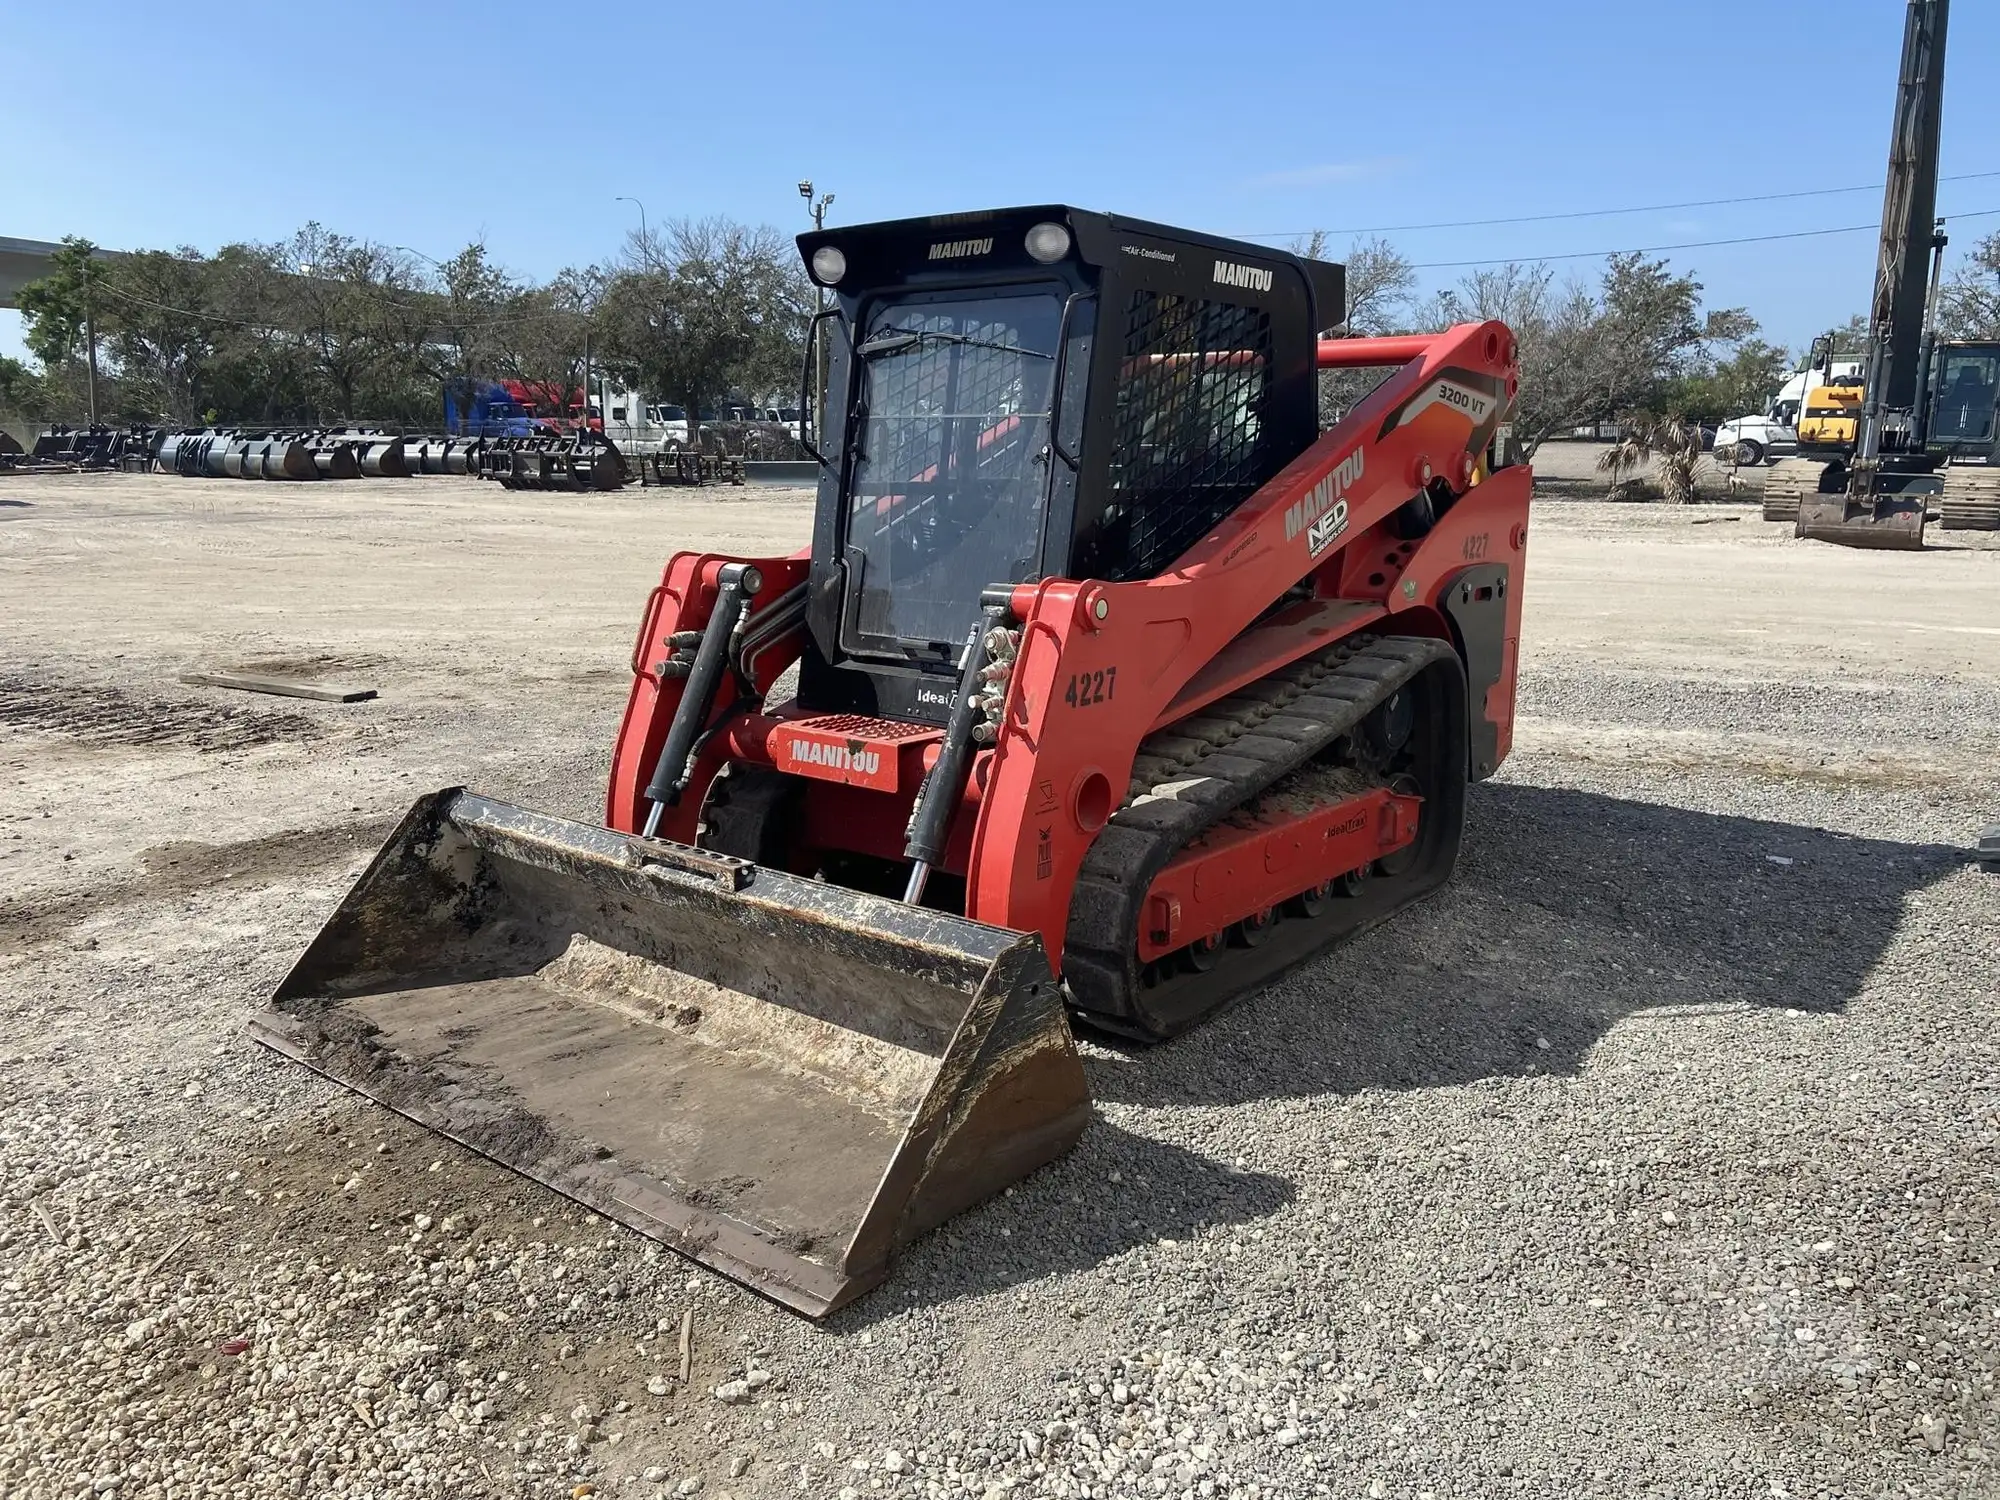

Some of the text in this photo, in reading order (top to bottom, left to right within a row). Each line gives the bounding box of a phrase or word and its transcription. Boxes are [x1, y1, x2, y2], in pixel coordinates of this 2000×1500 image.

[928, 238, 993, 260] MANITOU
[1130, 246, 1175, 263] Air-Conditioned
[1213, 260, 1273, 292] MANITOU
[1439, 384, 1485, 415] 3200 VT
[1285, 445, 1364, 542] MANITOU
[1308, 499, 1348, 550] NED
[1463, 533, 1489, 560] 4227
[1065, 667, 1117, 708] 4227
[792, 739, 880, 775] MANITOU
